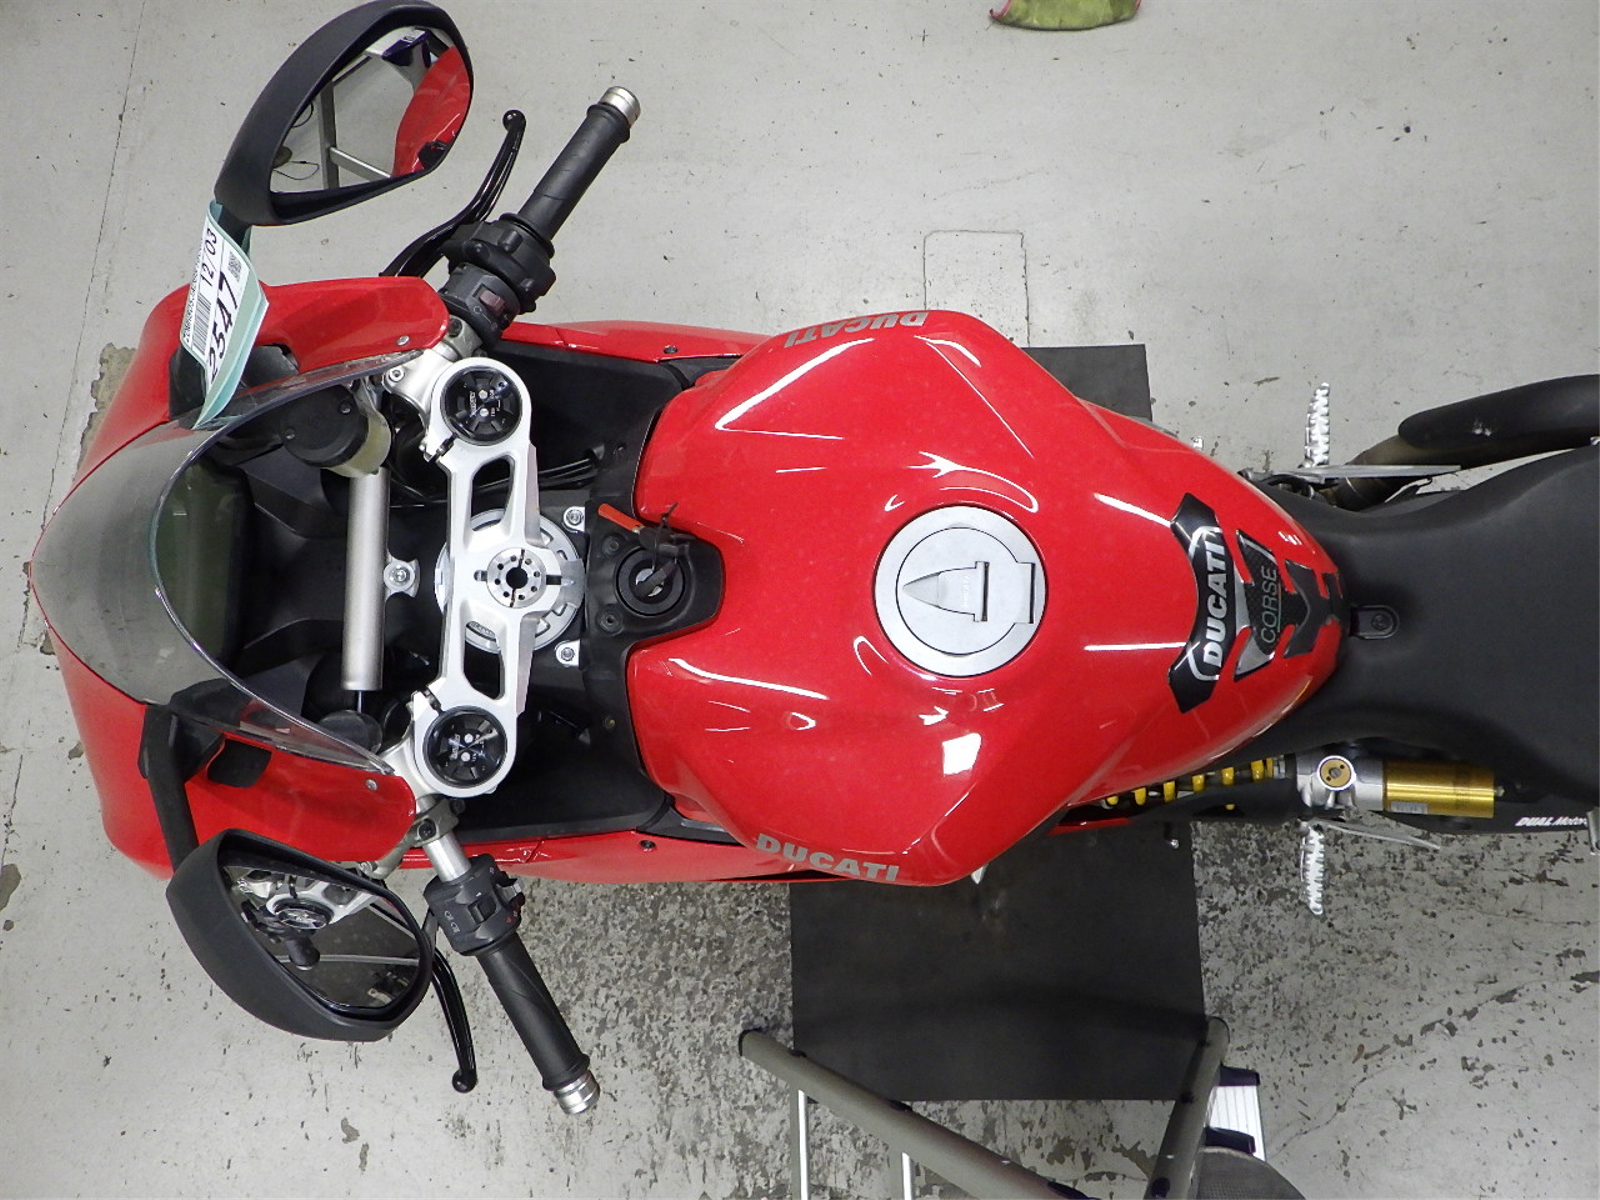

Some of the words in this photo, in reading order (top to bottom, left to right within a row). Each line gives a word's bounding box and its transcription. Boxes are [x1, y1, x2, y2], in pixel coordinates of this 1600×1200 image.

[200, 228, 218, 287] 12/03
[209, 271, 238, 383] 2547
[784, 312, 929, 348] DUCATI
[1203, 541, 1227, 668] DUCATI
[1260, 565, 1277, 644] CORSE
[1515, 817, 1554, 826] DUAL
[756, 833, 900, 881] DUCATI
